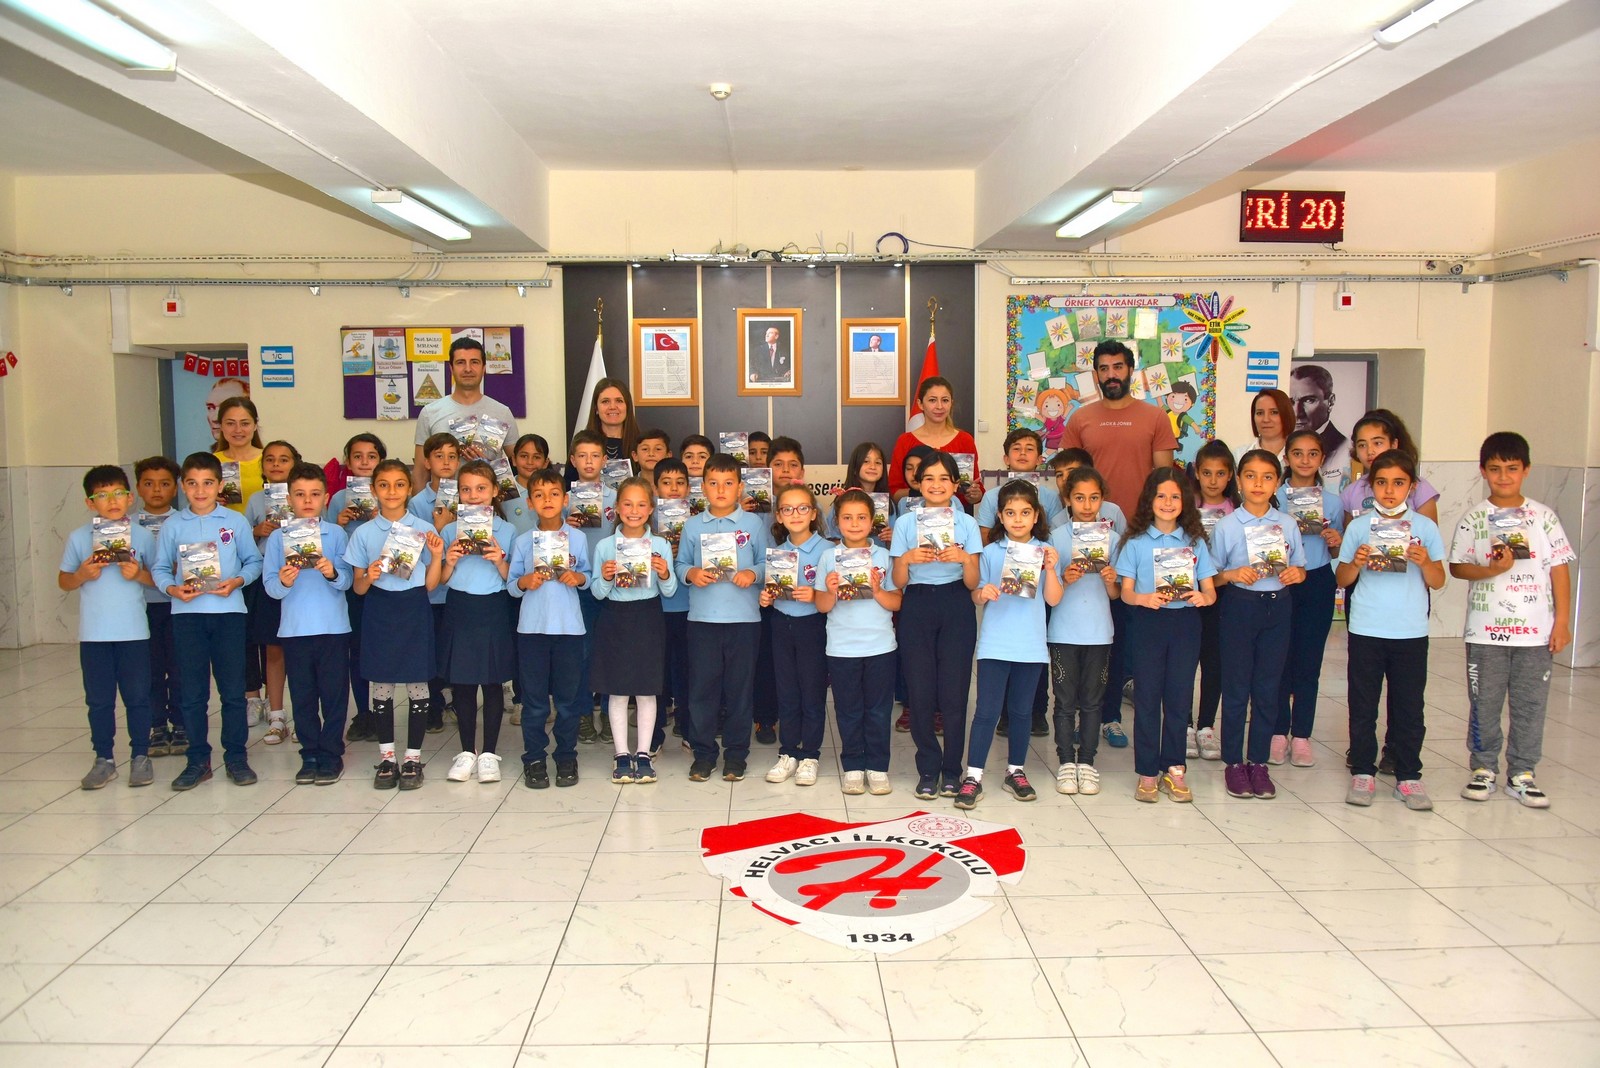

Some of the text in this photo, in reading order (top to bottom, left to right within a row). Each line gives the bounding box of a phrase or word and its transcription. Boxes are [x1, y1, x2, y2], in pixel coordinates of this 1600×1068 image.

[1300, 198, 1345, 230] 20
[1064, 297, 1159, 307] ÖRNEK DAVRANIŞLAR
[1257, 358, 1270, 366] 2/B
[1510, 574, 1536, 583] HAPPY
[1476, 582, 1496, 592] LOVE
[1472, 592, 1487, 602] YOU
[1523, 595, 1538, 604] DAY
[1494, 616, 1527, 626] HAPPY
[1484, 625, 1539, 635] MOTHER'S
[1490, 632, 1511, 642] DAY
[1467, 662, 1479, 697] NIKE
[744, 832, 993, 879] HELVACI İLKOKULU
[846, 932, 915, 944] 1934
